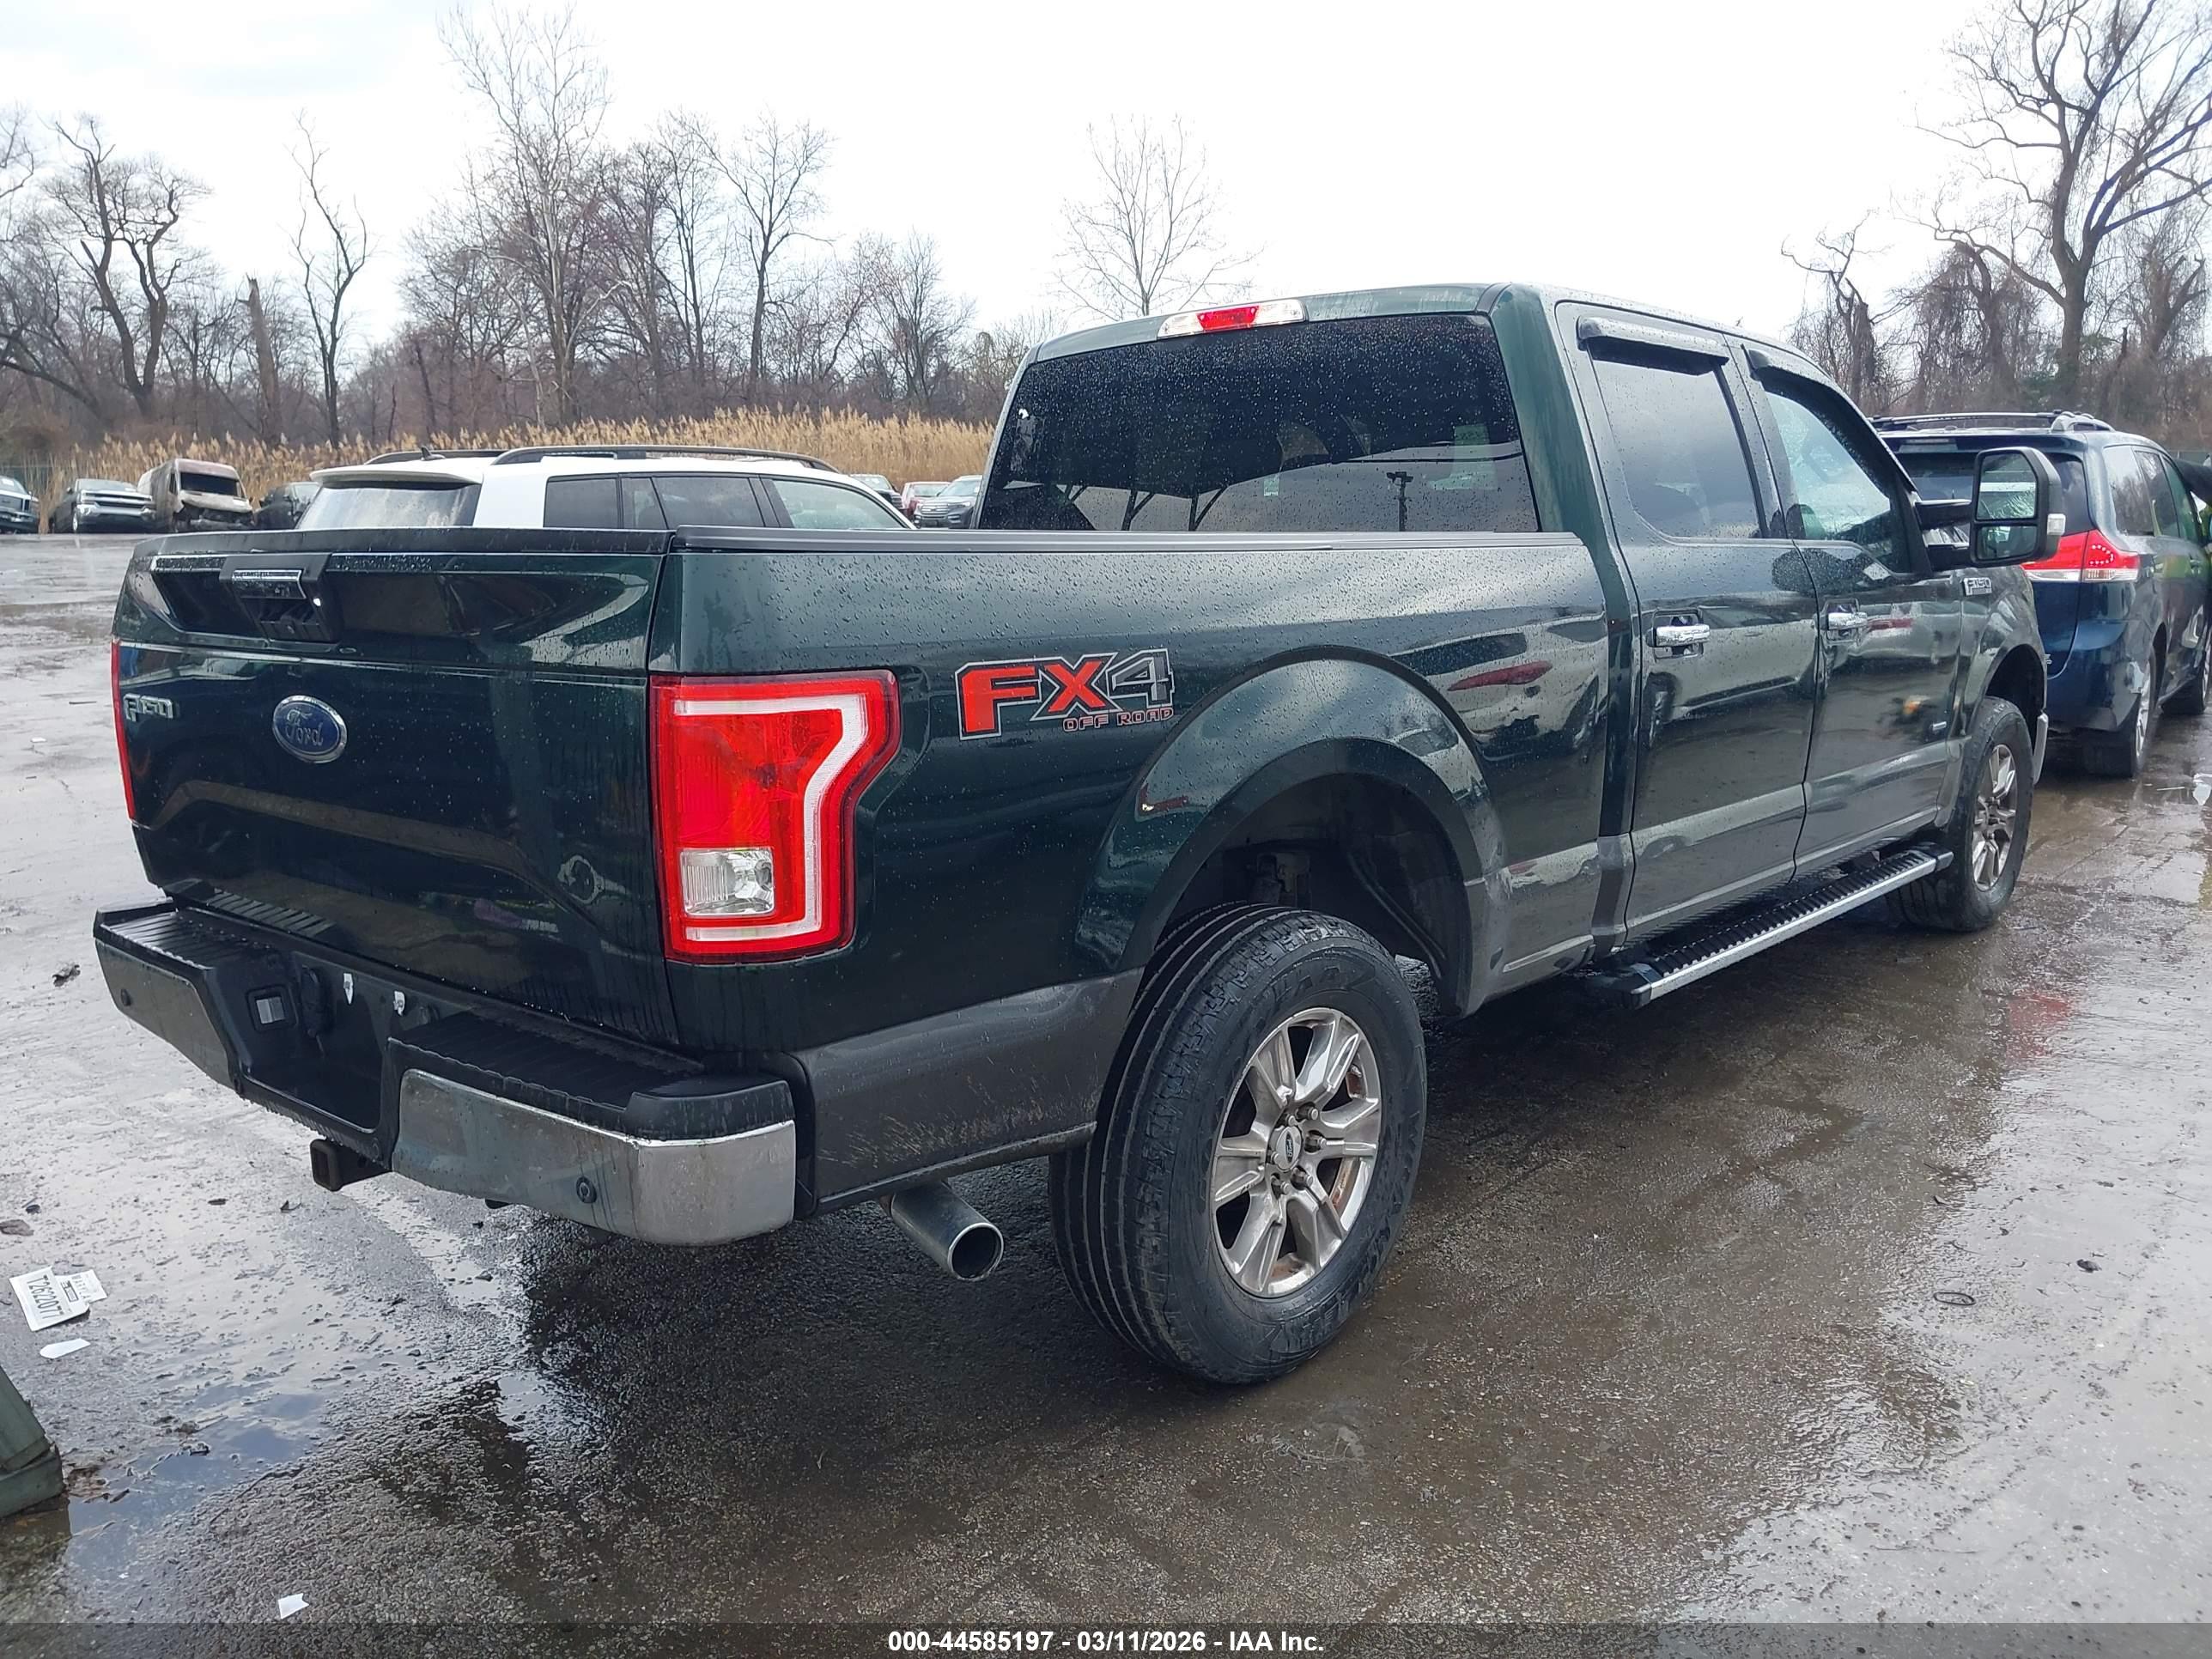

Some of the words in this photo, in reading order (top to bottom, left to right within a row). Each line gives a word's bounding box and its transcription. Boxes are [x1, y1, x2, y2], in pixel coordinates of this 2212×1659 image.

[955, 648, 1175, 739] FX4
[1063, 715, 1109, 732] OFF
[1117, 708, 1173, 726] ROAD
